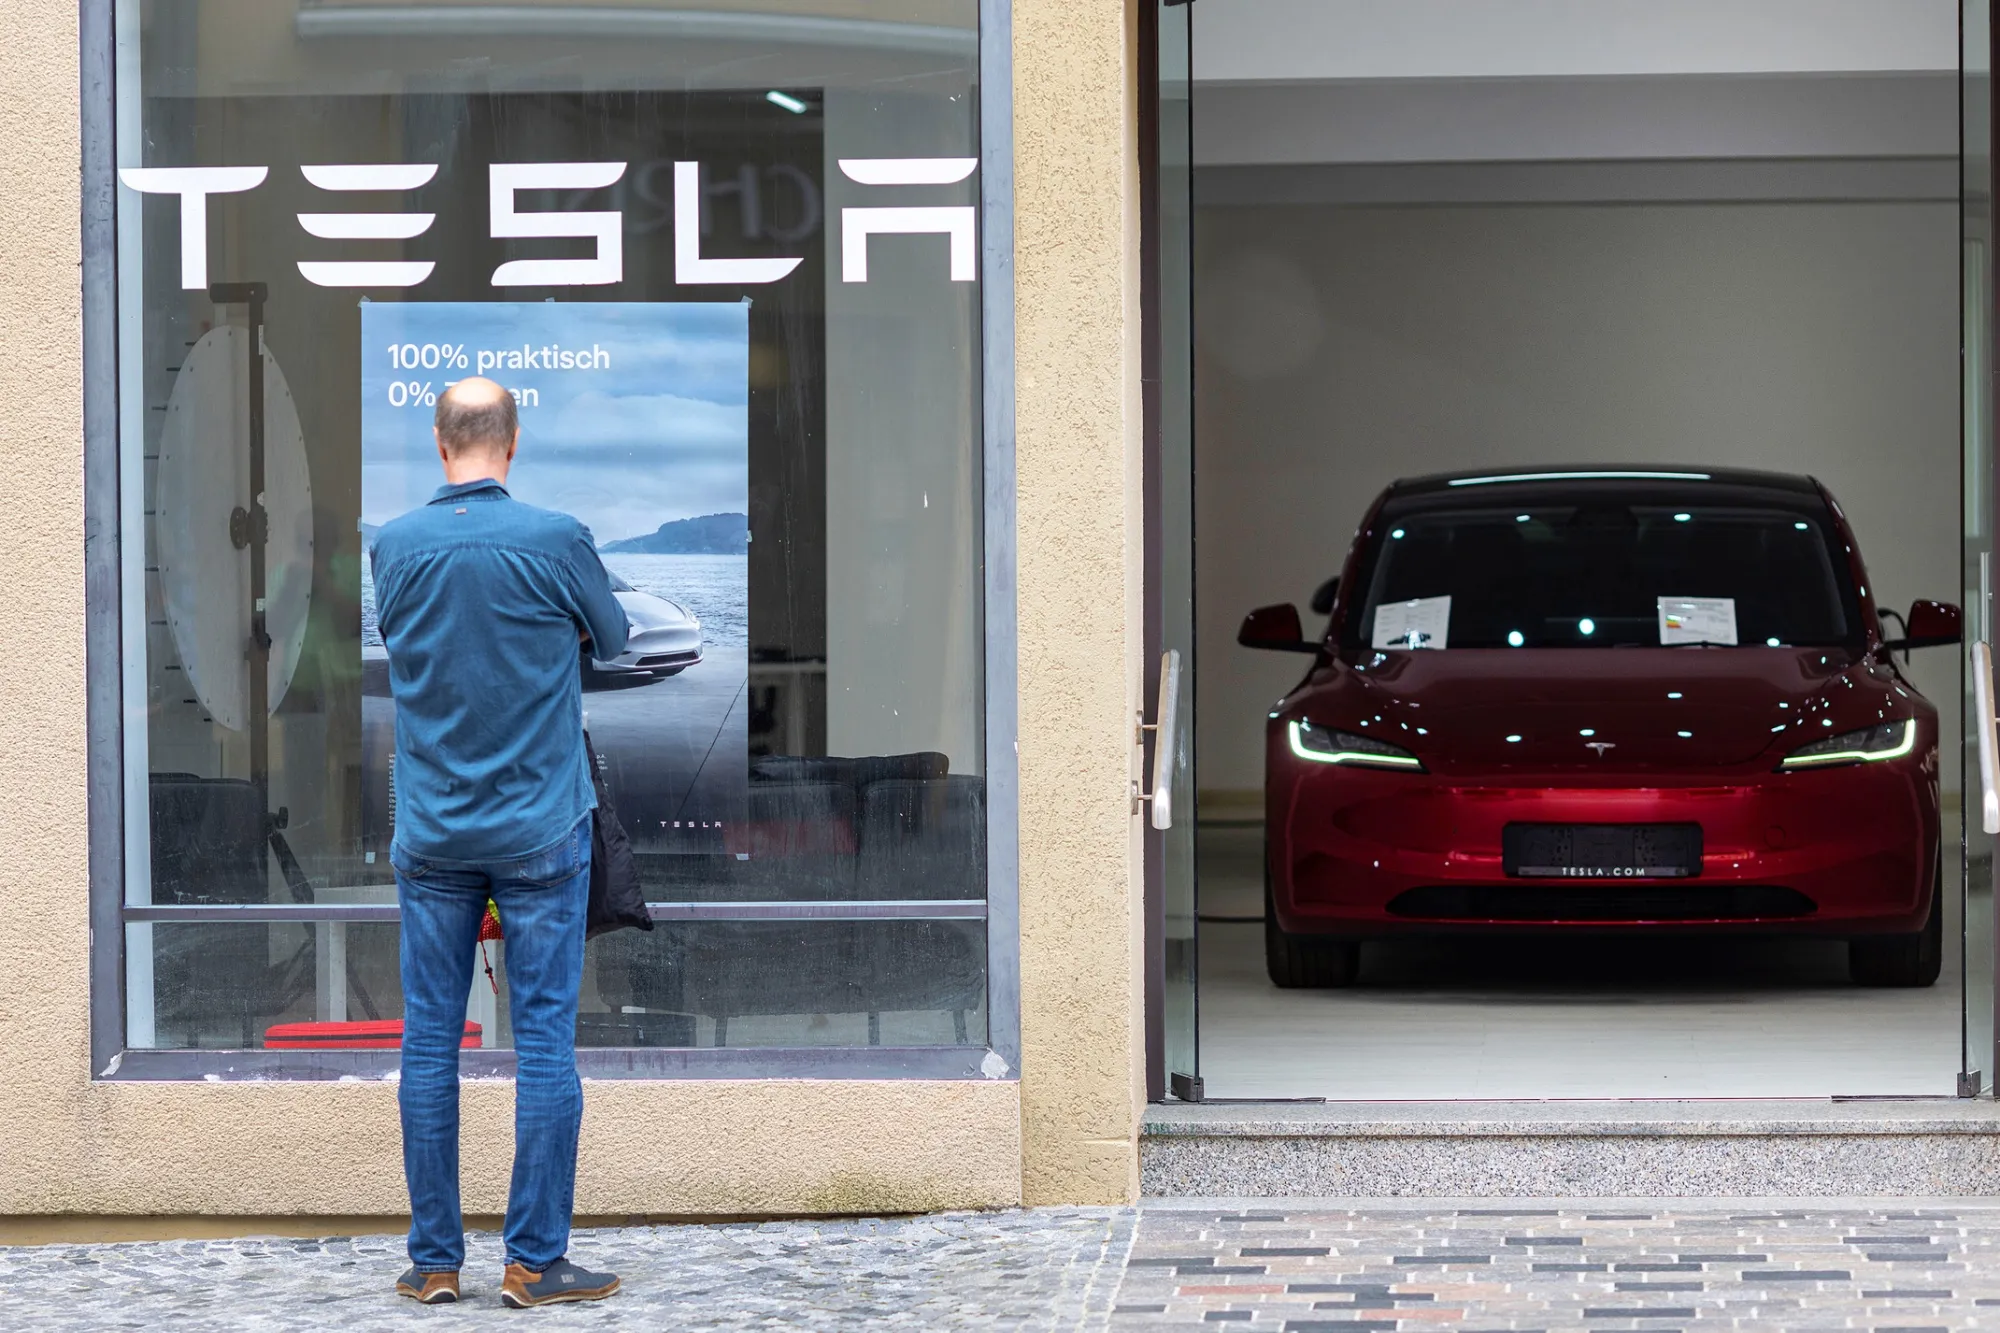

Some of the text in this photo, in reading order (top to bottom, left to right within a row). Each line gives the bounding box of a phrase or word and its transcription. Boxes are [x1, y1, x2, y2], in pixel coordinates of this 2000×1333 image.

[118, 158, 978, 290] TESLA
[387, 343, 610, 375] 100% praktisch
[388, 381, 436, 407] 0%
[1562, 866, 1645, 877] TESLA.COM
